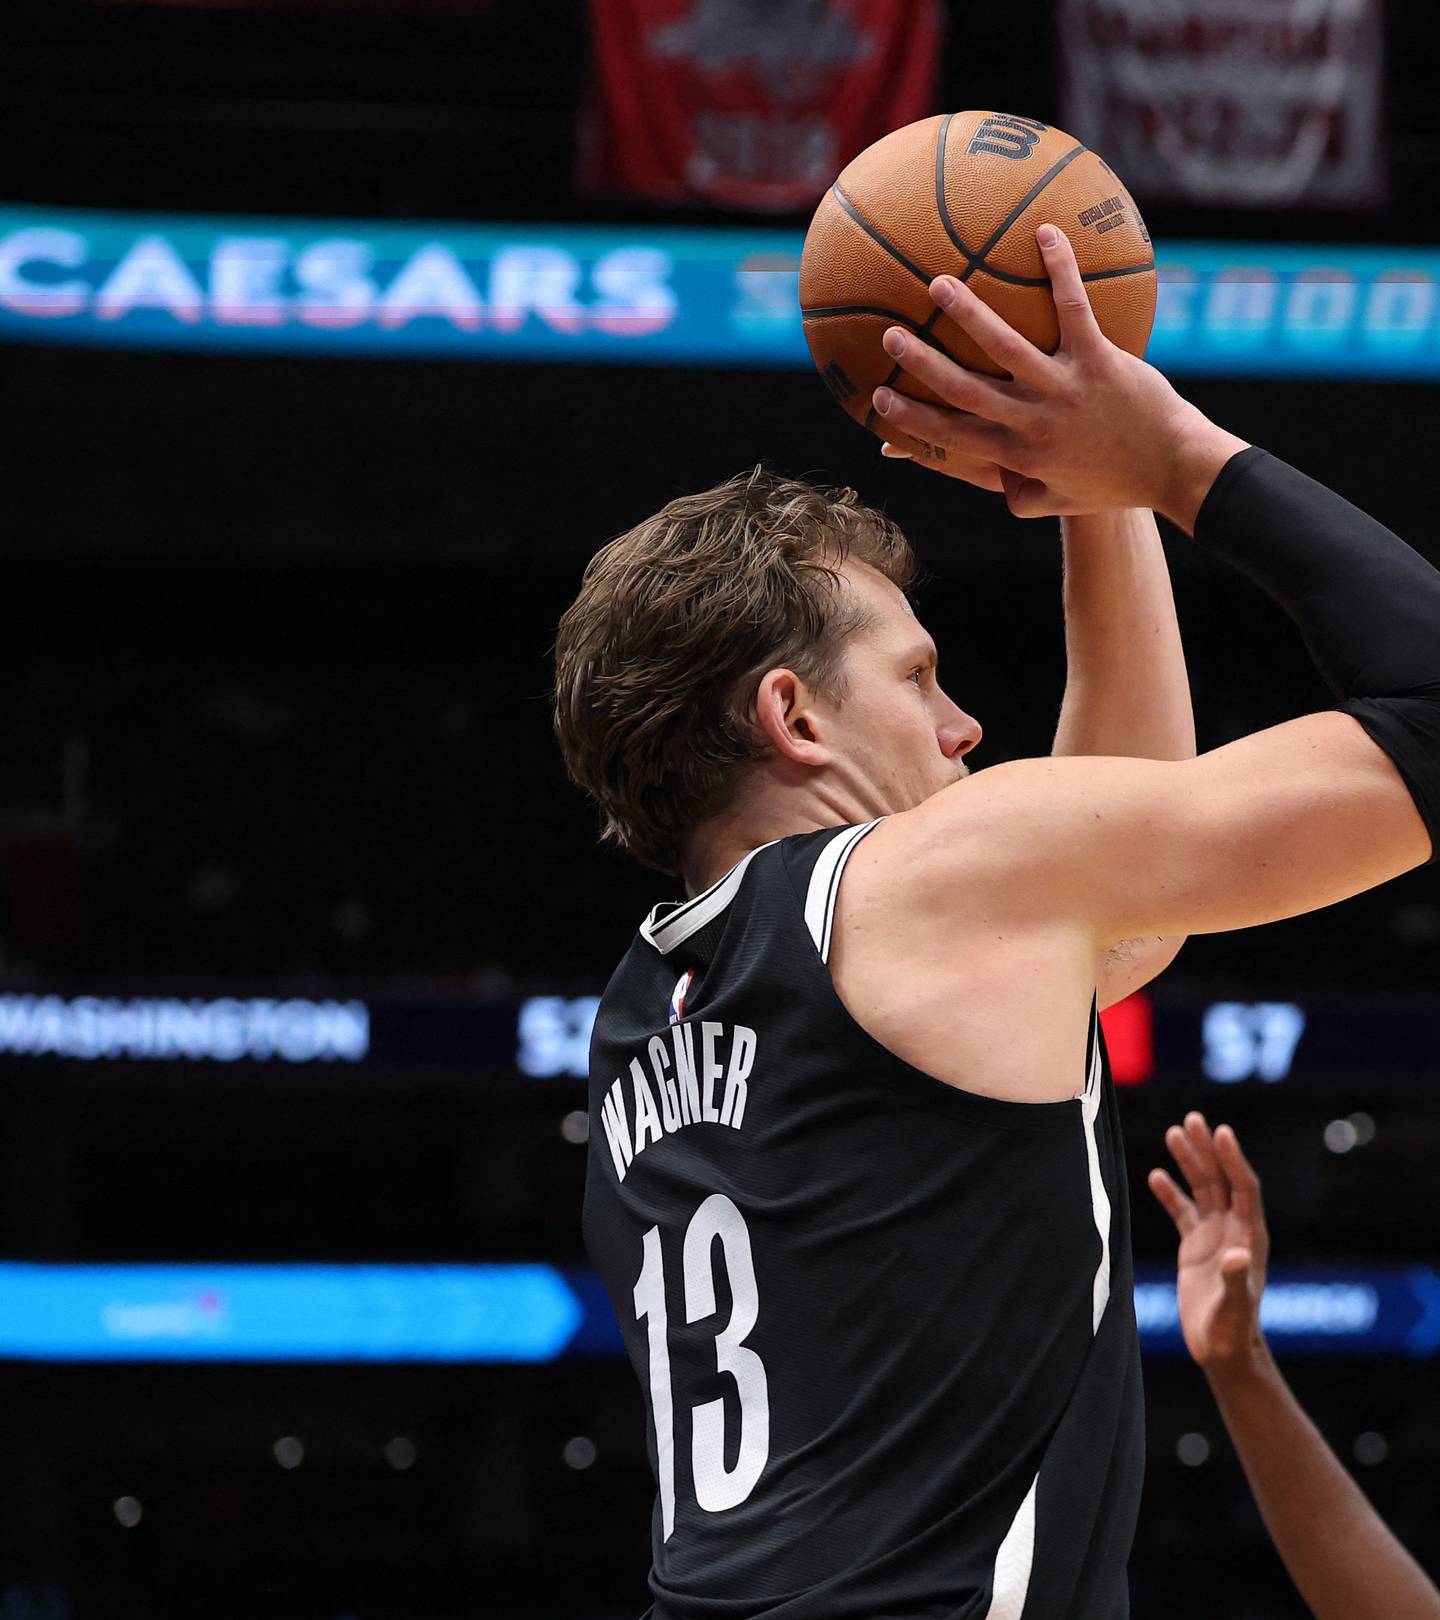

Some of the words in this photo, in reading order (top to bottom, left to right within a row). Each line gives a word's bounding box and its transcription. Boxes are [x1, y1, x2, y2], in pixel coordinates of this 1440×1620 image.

[0, 226, 677, 337] CAESARS
[0, 993, 370, 1062] WASHINGTON
[1202, 1002, 1304, 1082] 57
[601, 1021, 757, 1183] WAGNER
[633, 1194, 770, 1543] 13
